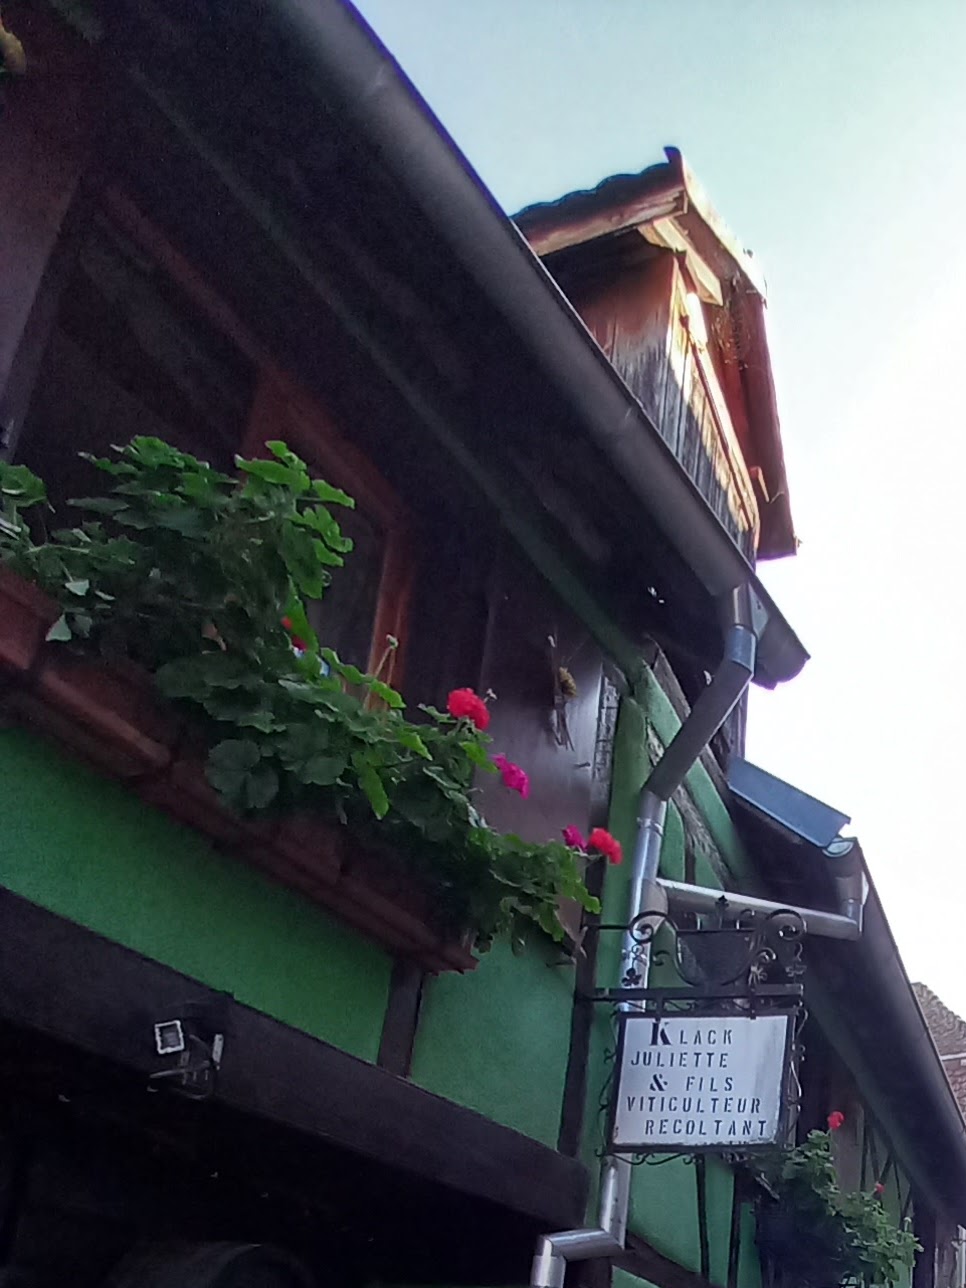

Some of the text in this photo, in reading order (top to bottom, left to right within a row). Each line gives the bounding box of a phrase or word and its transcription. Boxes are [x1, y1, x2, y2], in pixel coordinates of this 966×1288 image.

[650, 1022, 733, 1046] KLACK
[631, 1051, 728, 1068] JULIETTE
[650, 1074, 733, 1092] & FILS
[627, 1096, 761, 1113] VITICULTEUR
[645, 1119, 767, 1136] RECOLTANT
